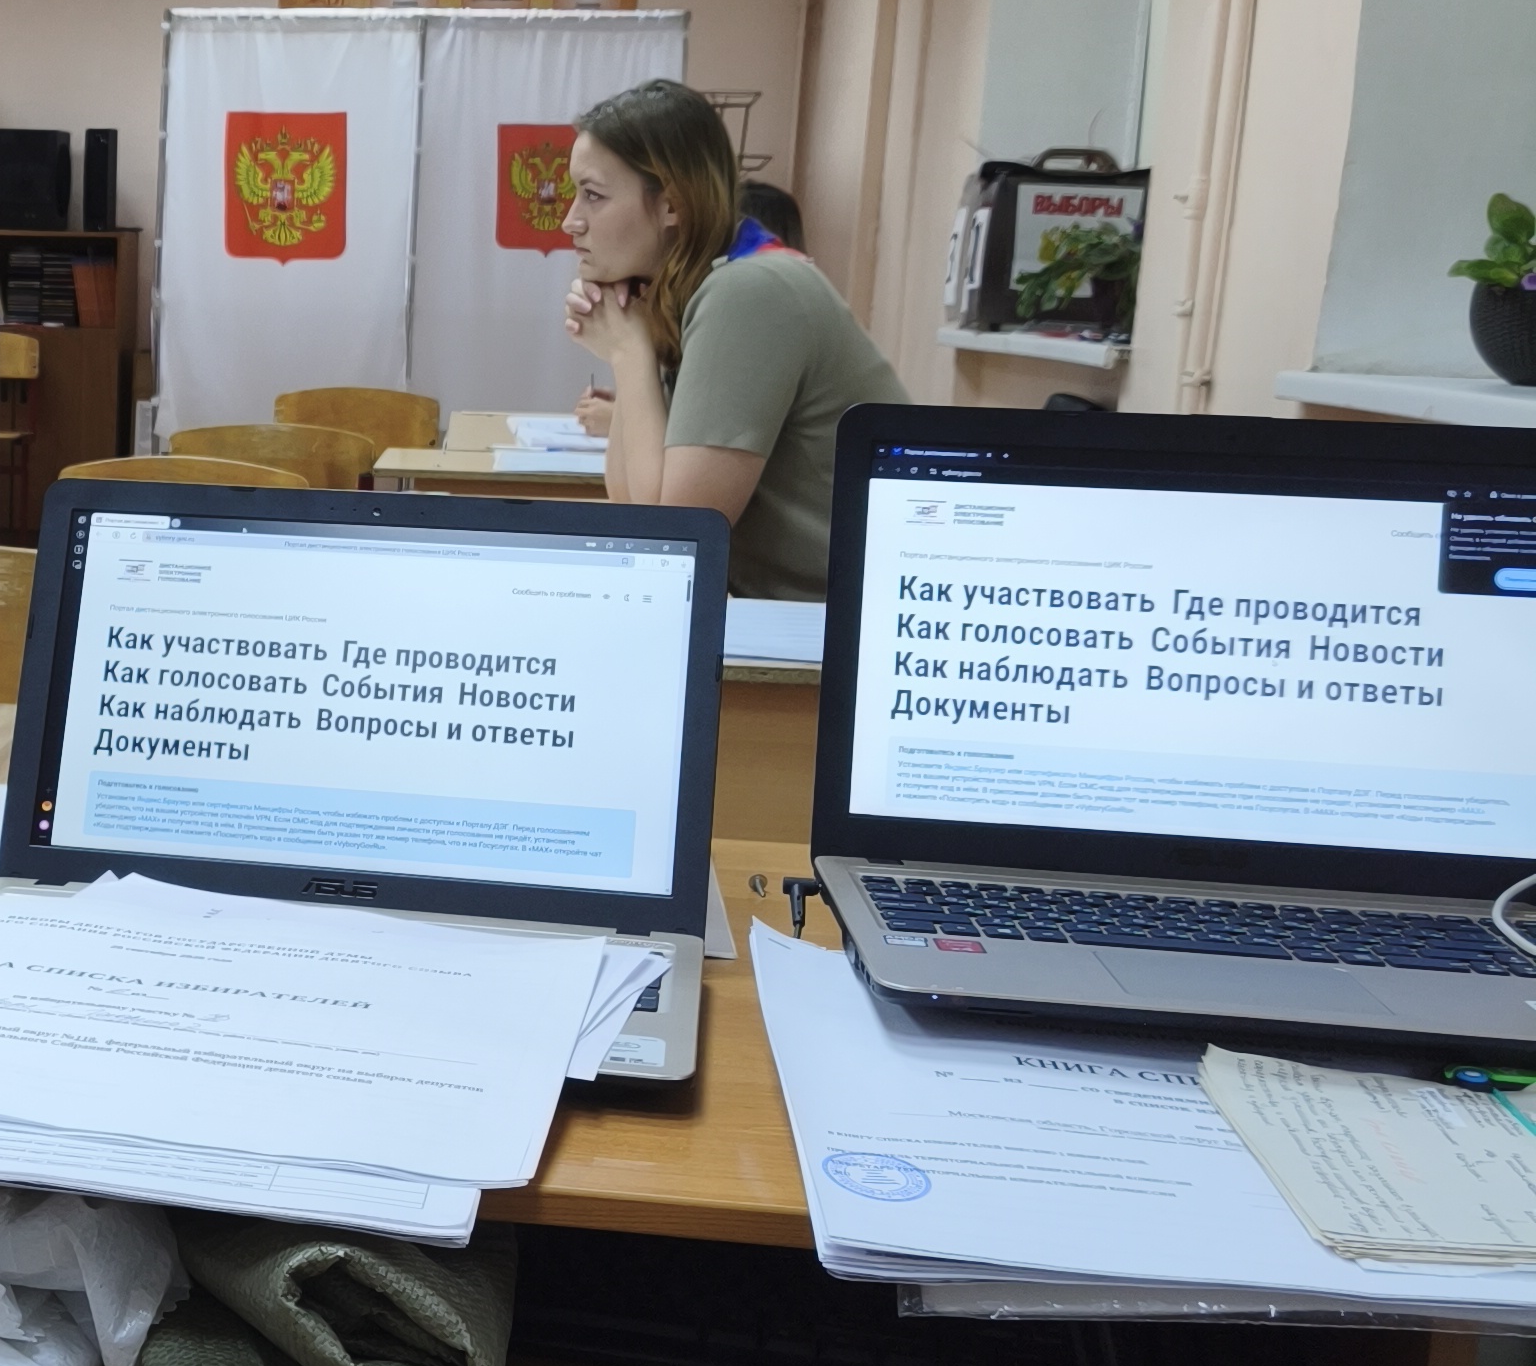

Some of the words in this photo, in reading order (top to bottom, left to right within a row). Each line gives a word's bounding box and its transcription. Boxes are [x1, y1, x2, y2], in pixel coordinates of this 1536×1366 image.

[1031, 192, 1123, 218] ВЫБОРЫ
[898, 574, 953, 603] Как
[962, 583, 1155, 613] участвовать
[1172, 588, 1224, 621] Где
[1234, 597, 1420, 629] проводится
[106, 625, 154, 651] Как
[161, 634, 328, 661] участвовать
[341, 639, 387, 669] Где
[394, 648, 556, 677] проводится
[896, 612, 950, 641] Как
[960, 622, 1134, 650] голосовать
[1150, 626, 1291, 659] События
[1309, 634, 1444, 667] Новости
[102, 659, 150, 685] Как
[157, 668, 308, 695] голосовать
[322, 672, 443, 704] События
[458, 681, 576, 713] Новости
[894, 650, 948, 679] Как
[958, 654, 1128, 692] наблюдать
[1145, 664, 1285, 701] Вопросы
[1296, 679, 1314, 699] и
[1324, 680, 1443, 707] ответы
[98, 693, 146, 719] Как
[154, 697, 301, 731] наблюдать
[315, 707, 437, 741] Вопросы
[446, 721, 462, 741] и
[470, 723, 574, 748] ответы
[890, 689, 1070, 725] Документы
[92, 727, 250, 761] Документы
[301, 876, 378, 899] ASUS
[7, 915, 70, 924] ВЫБОРЫ
[73, 922, 163, 939] ДЕПУТАТОВ
[167, 936, 320, 955] ГОСУДАРСТВЕННОЙ
[324, 951, 373, 960] ДУМЫ
[221, 947, 315, 959] ФЕДЕРАЦИИ
[26, 964, 144, 985] СПИСКА
[153, 980, 373, 1009] ИЗБИРАТЕЛЕЙ
[1012, 1055, 1131, 1079] КНИГА
[1137, 1071, 1202, 1086] СПИ
[1080, 1085, 1101, 1093] со
[1127, 1099, 1191, 1112] список
[947, 1109, 1034, 1124] Московская
